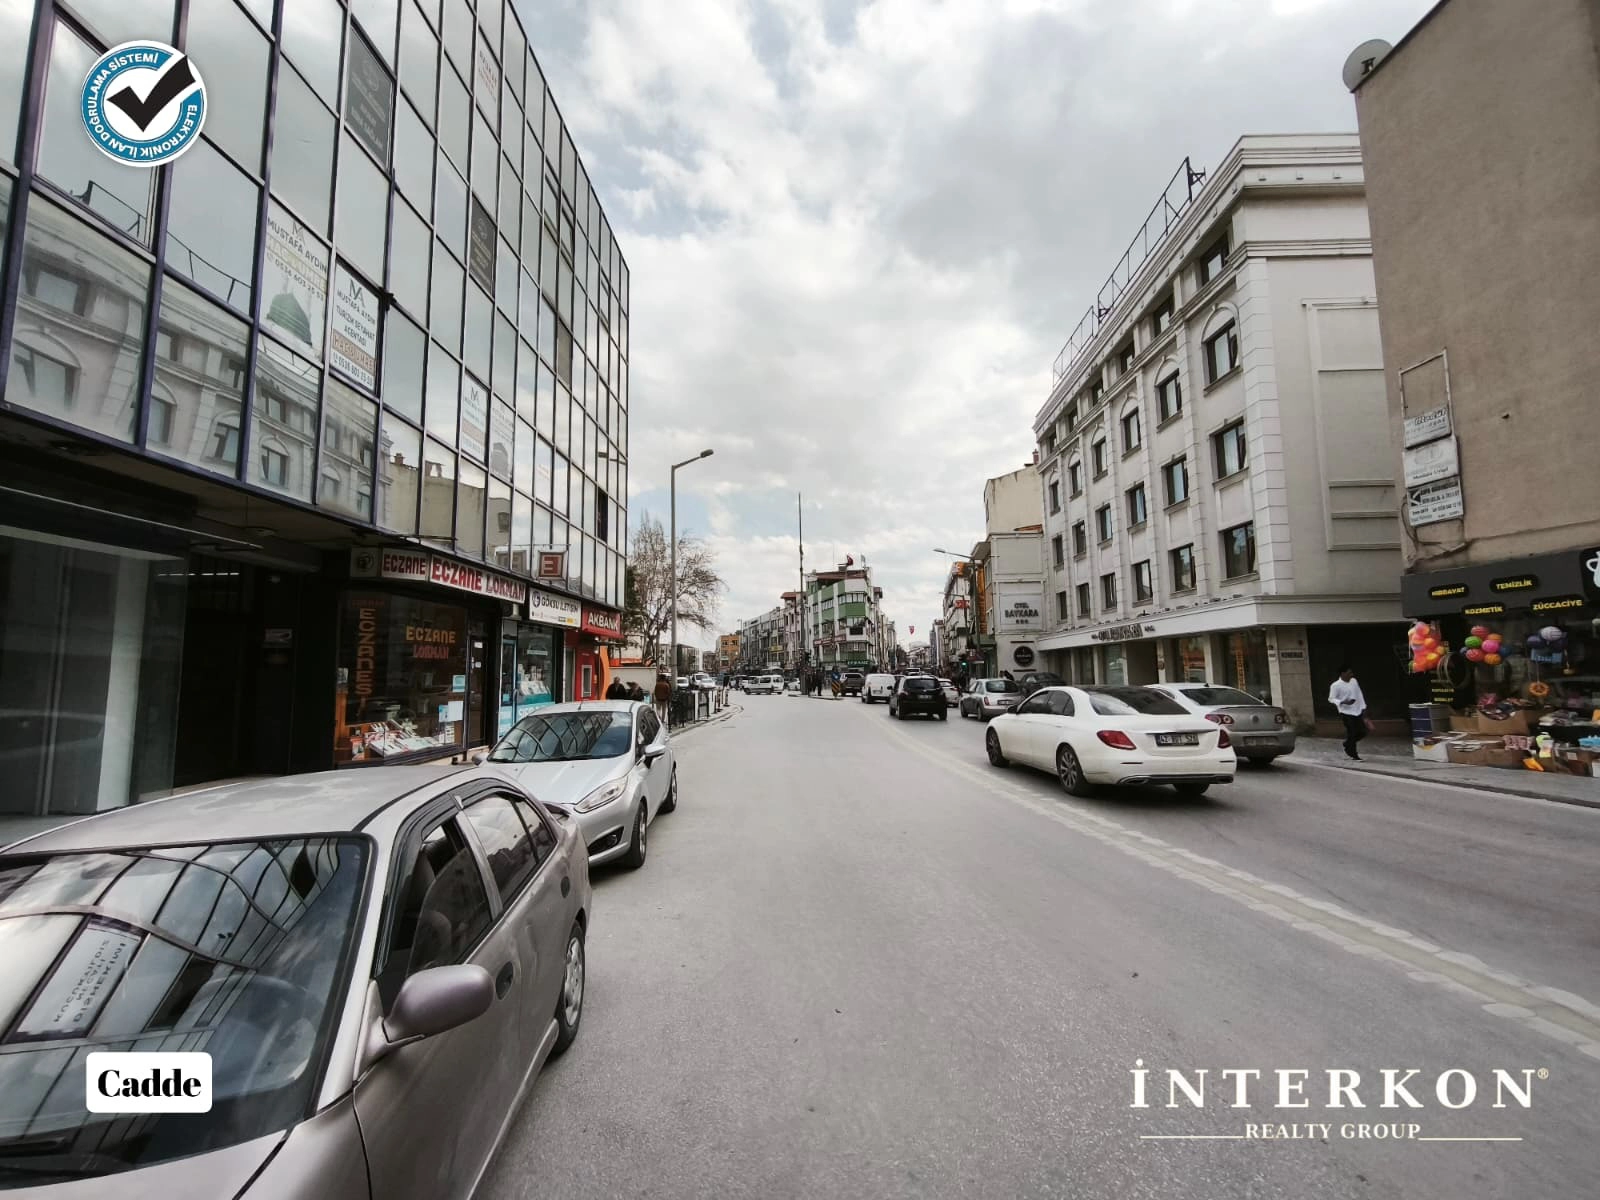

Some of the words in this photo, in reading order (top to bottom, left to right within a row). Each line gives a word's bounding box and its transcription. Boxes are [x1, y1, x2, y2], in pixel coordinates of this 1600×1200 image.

[267, 217, 303, 254] MUSTAFA
[383, 555, 426, 575] ECZANE
[431, 557, 483, 591] ECZANE
[587, 611, 618, 632] AKBANK
[405, 625, 456, 644] ECZANE
